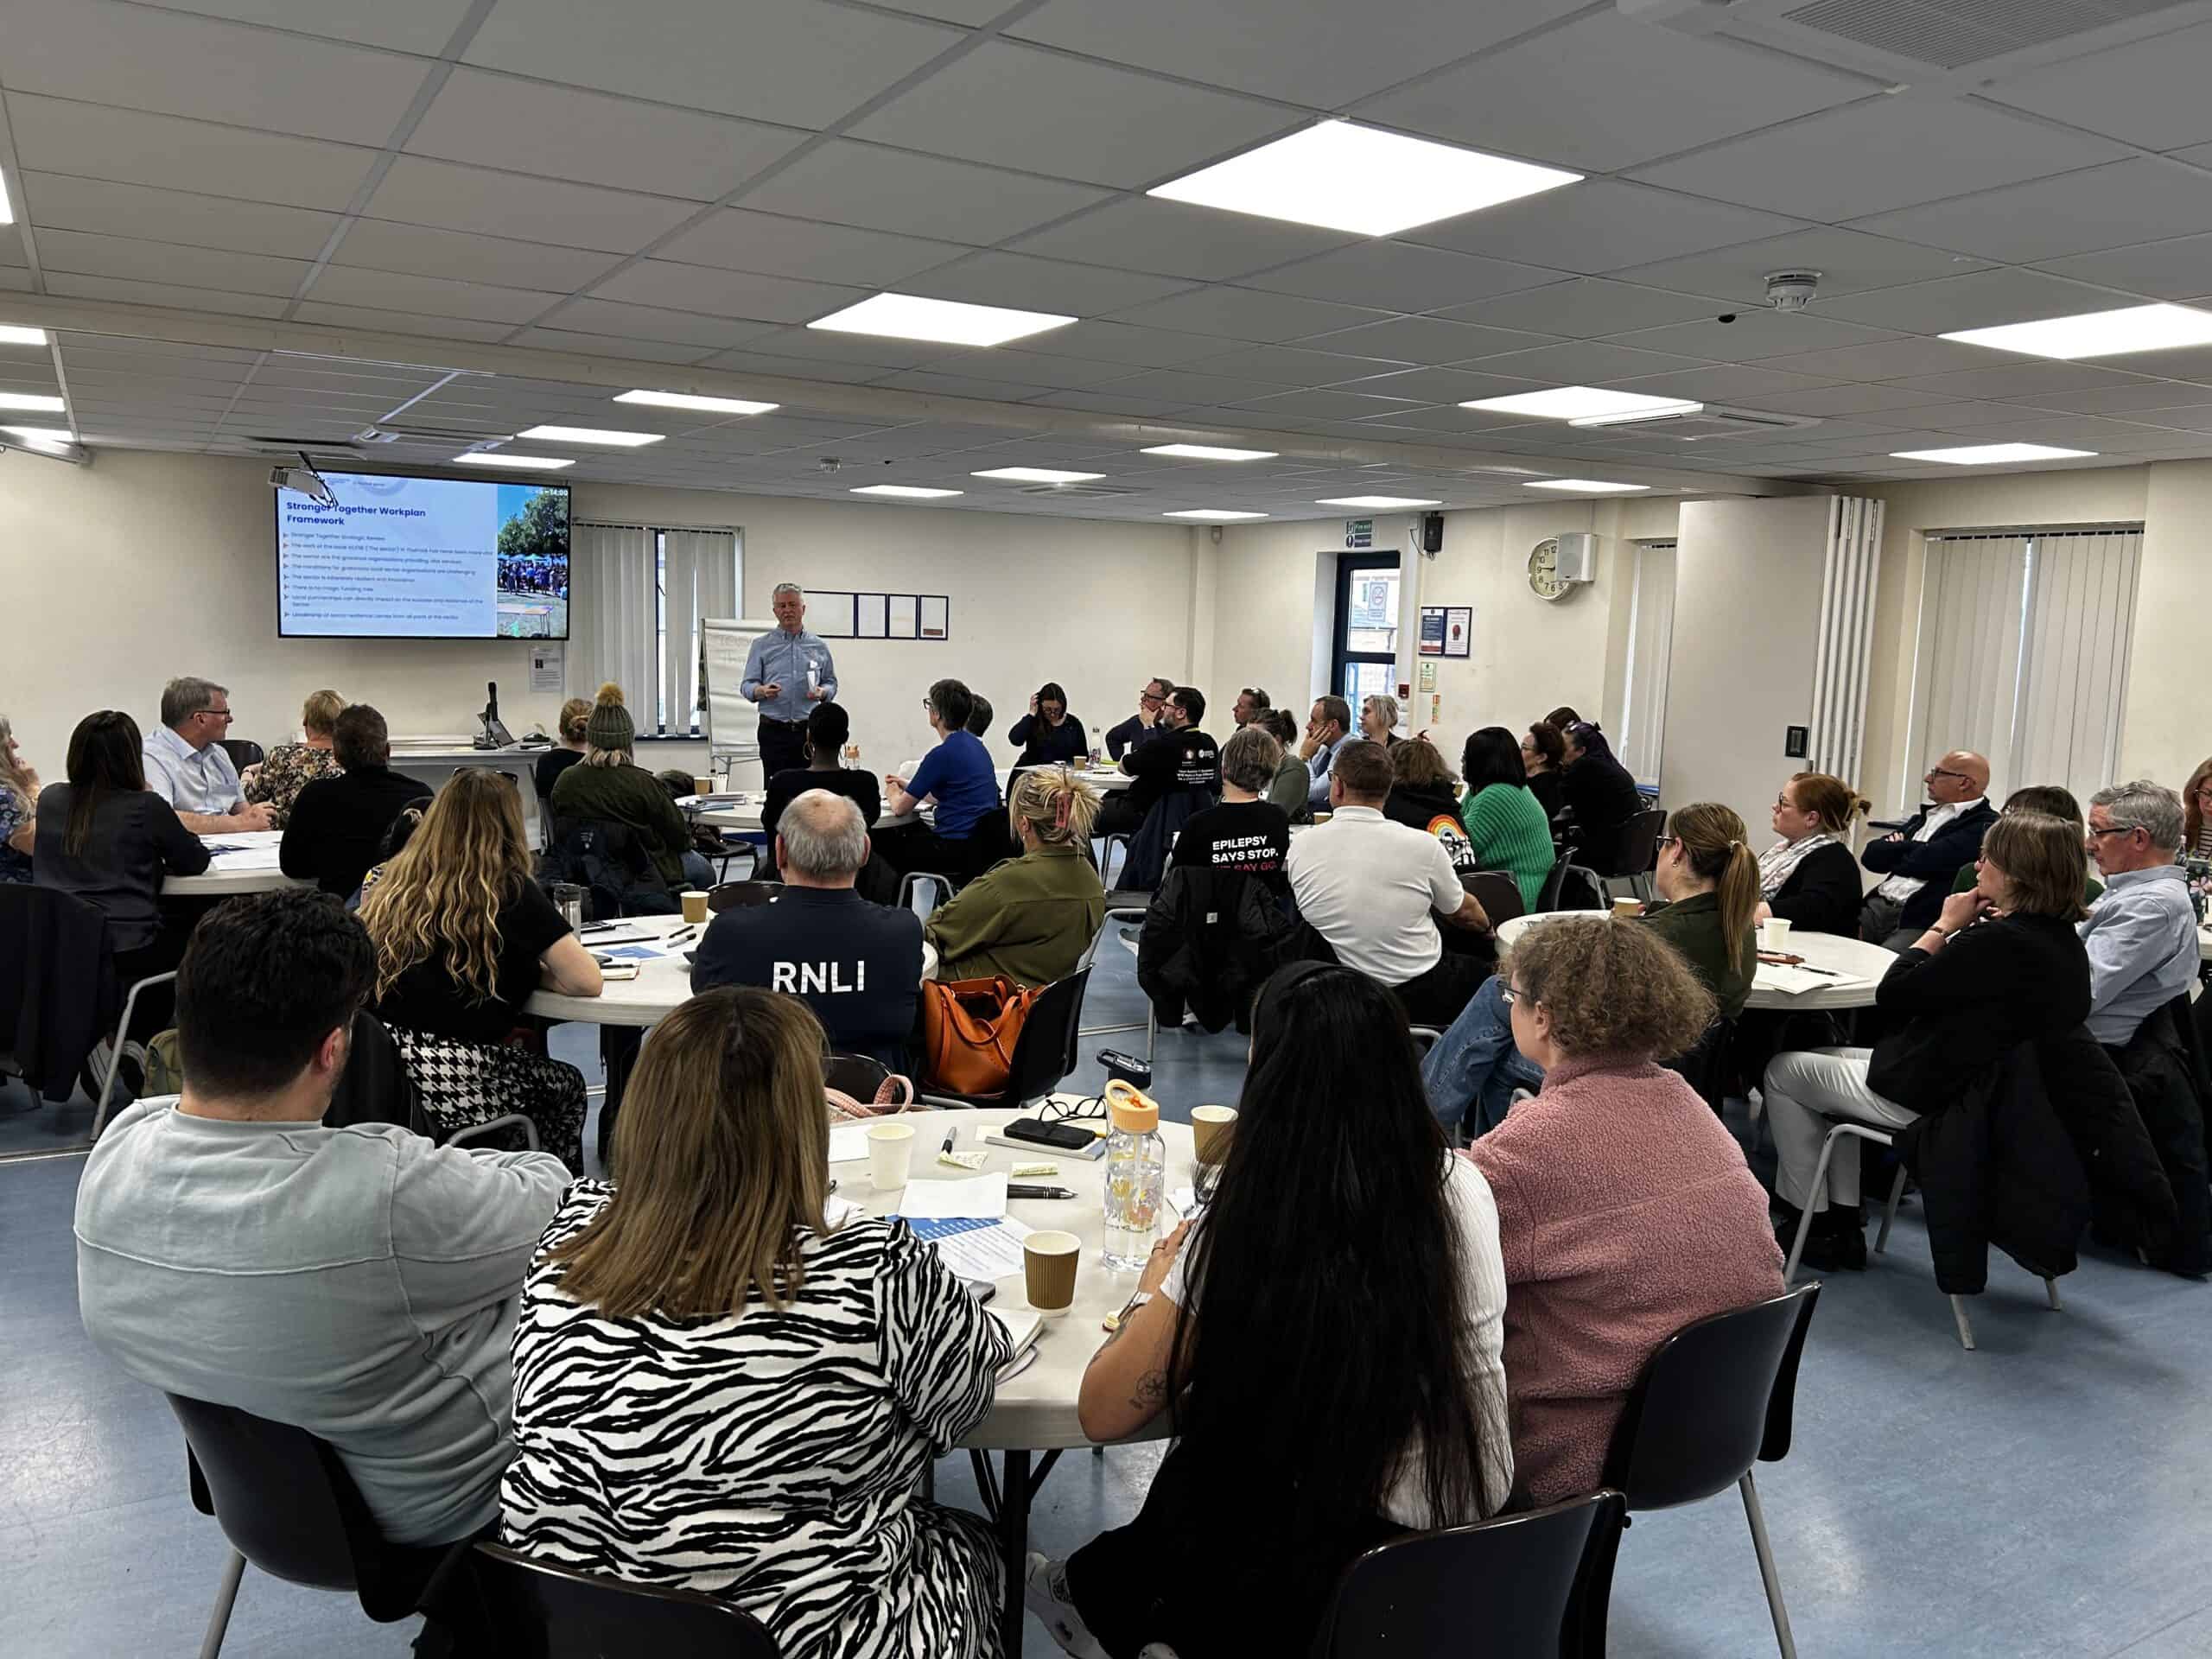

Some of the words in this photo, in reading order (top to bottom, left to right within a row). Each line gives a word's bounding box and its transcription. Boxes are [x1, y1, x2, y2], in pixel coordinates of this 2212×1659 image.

[287, 515, 345, 525] Framework
[379, 507, 427, 518] Workplan
[1212, 835, 1268, 851] EPILEPSY
[1211, 851, 1245, 863] SAYS
[1247, 848, 1279, 860] STOP.
[772, 960, 865, 995] RNLI
